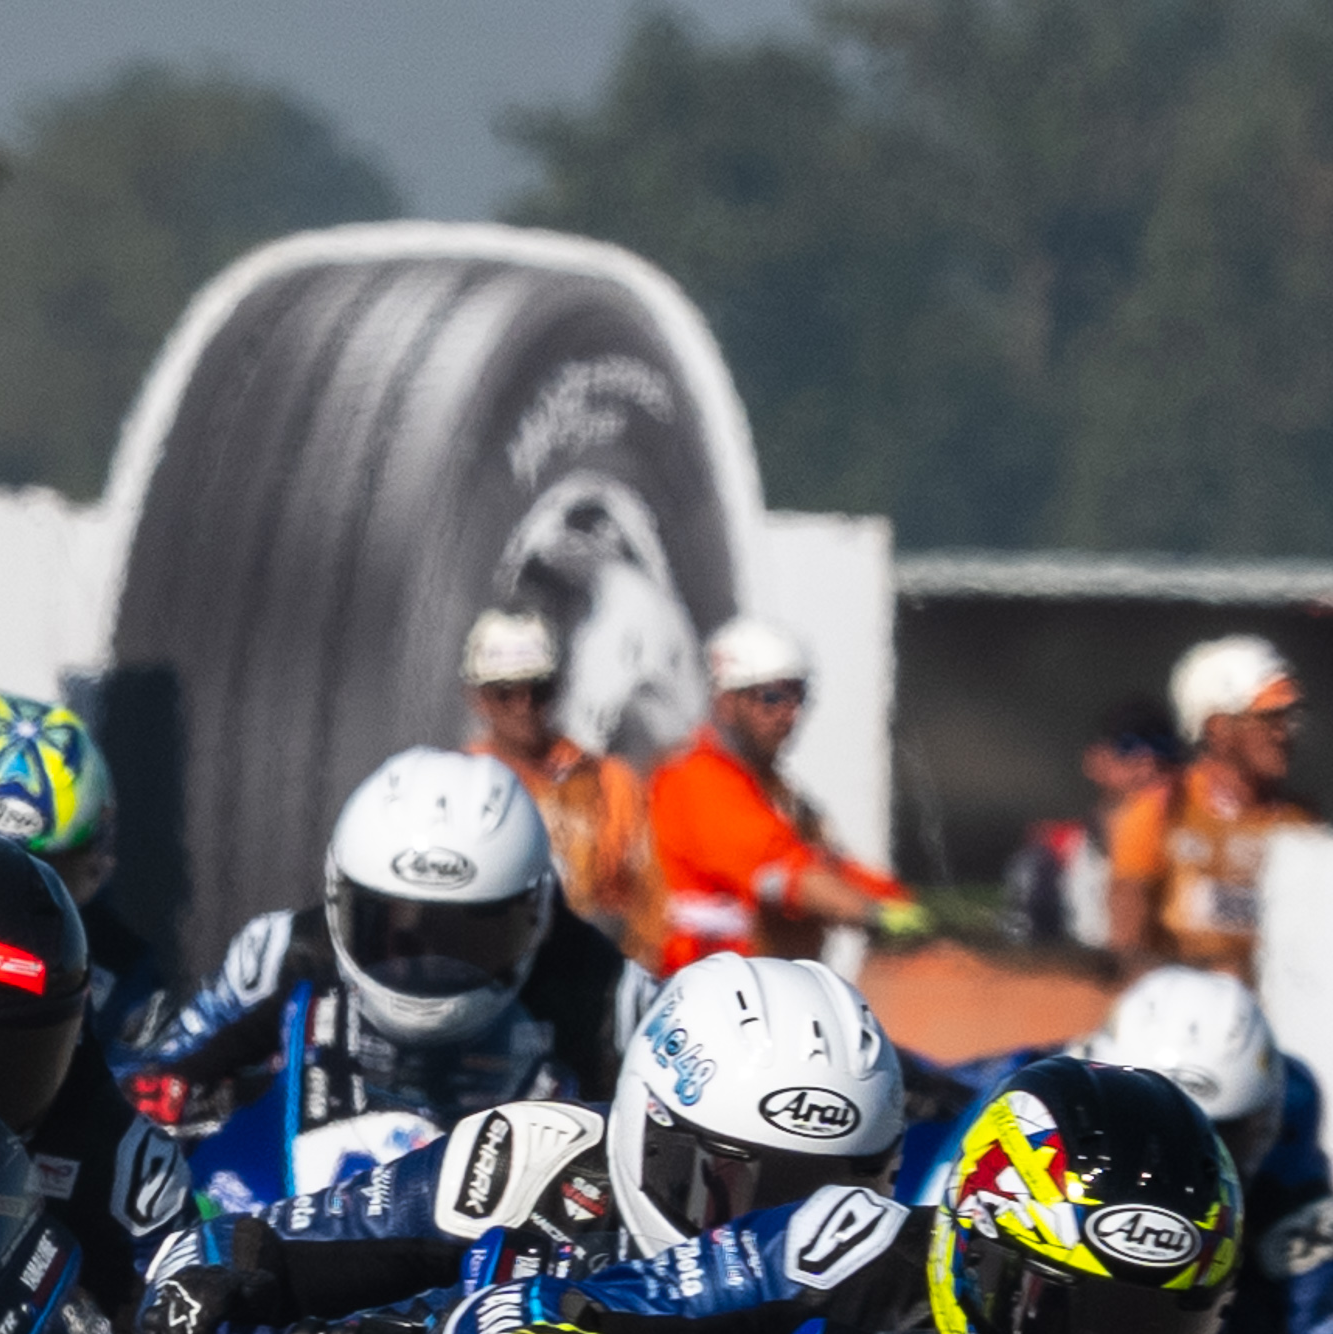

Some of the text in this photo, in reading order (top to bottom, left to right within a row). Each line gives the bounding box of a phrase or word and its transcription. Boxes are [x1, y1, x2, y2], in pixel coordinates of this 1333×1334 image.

[777, 1091, 853, 1127] Arai
[464, 1116, 509, 1214] SHARK
[1102, 1212, 1188, 1253] Arai
